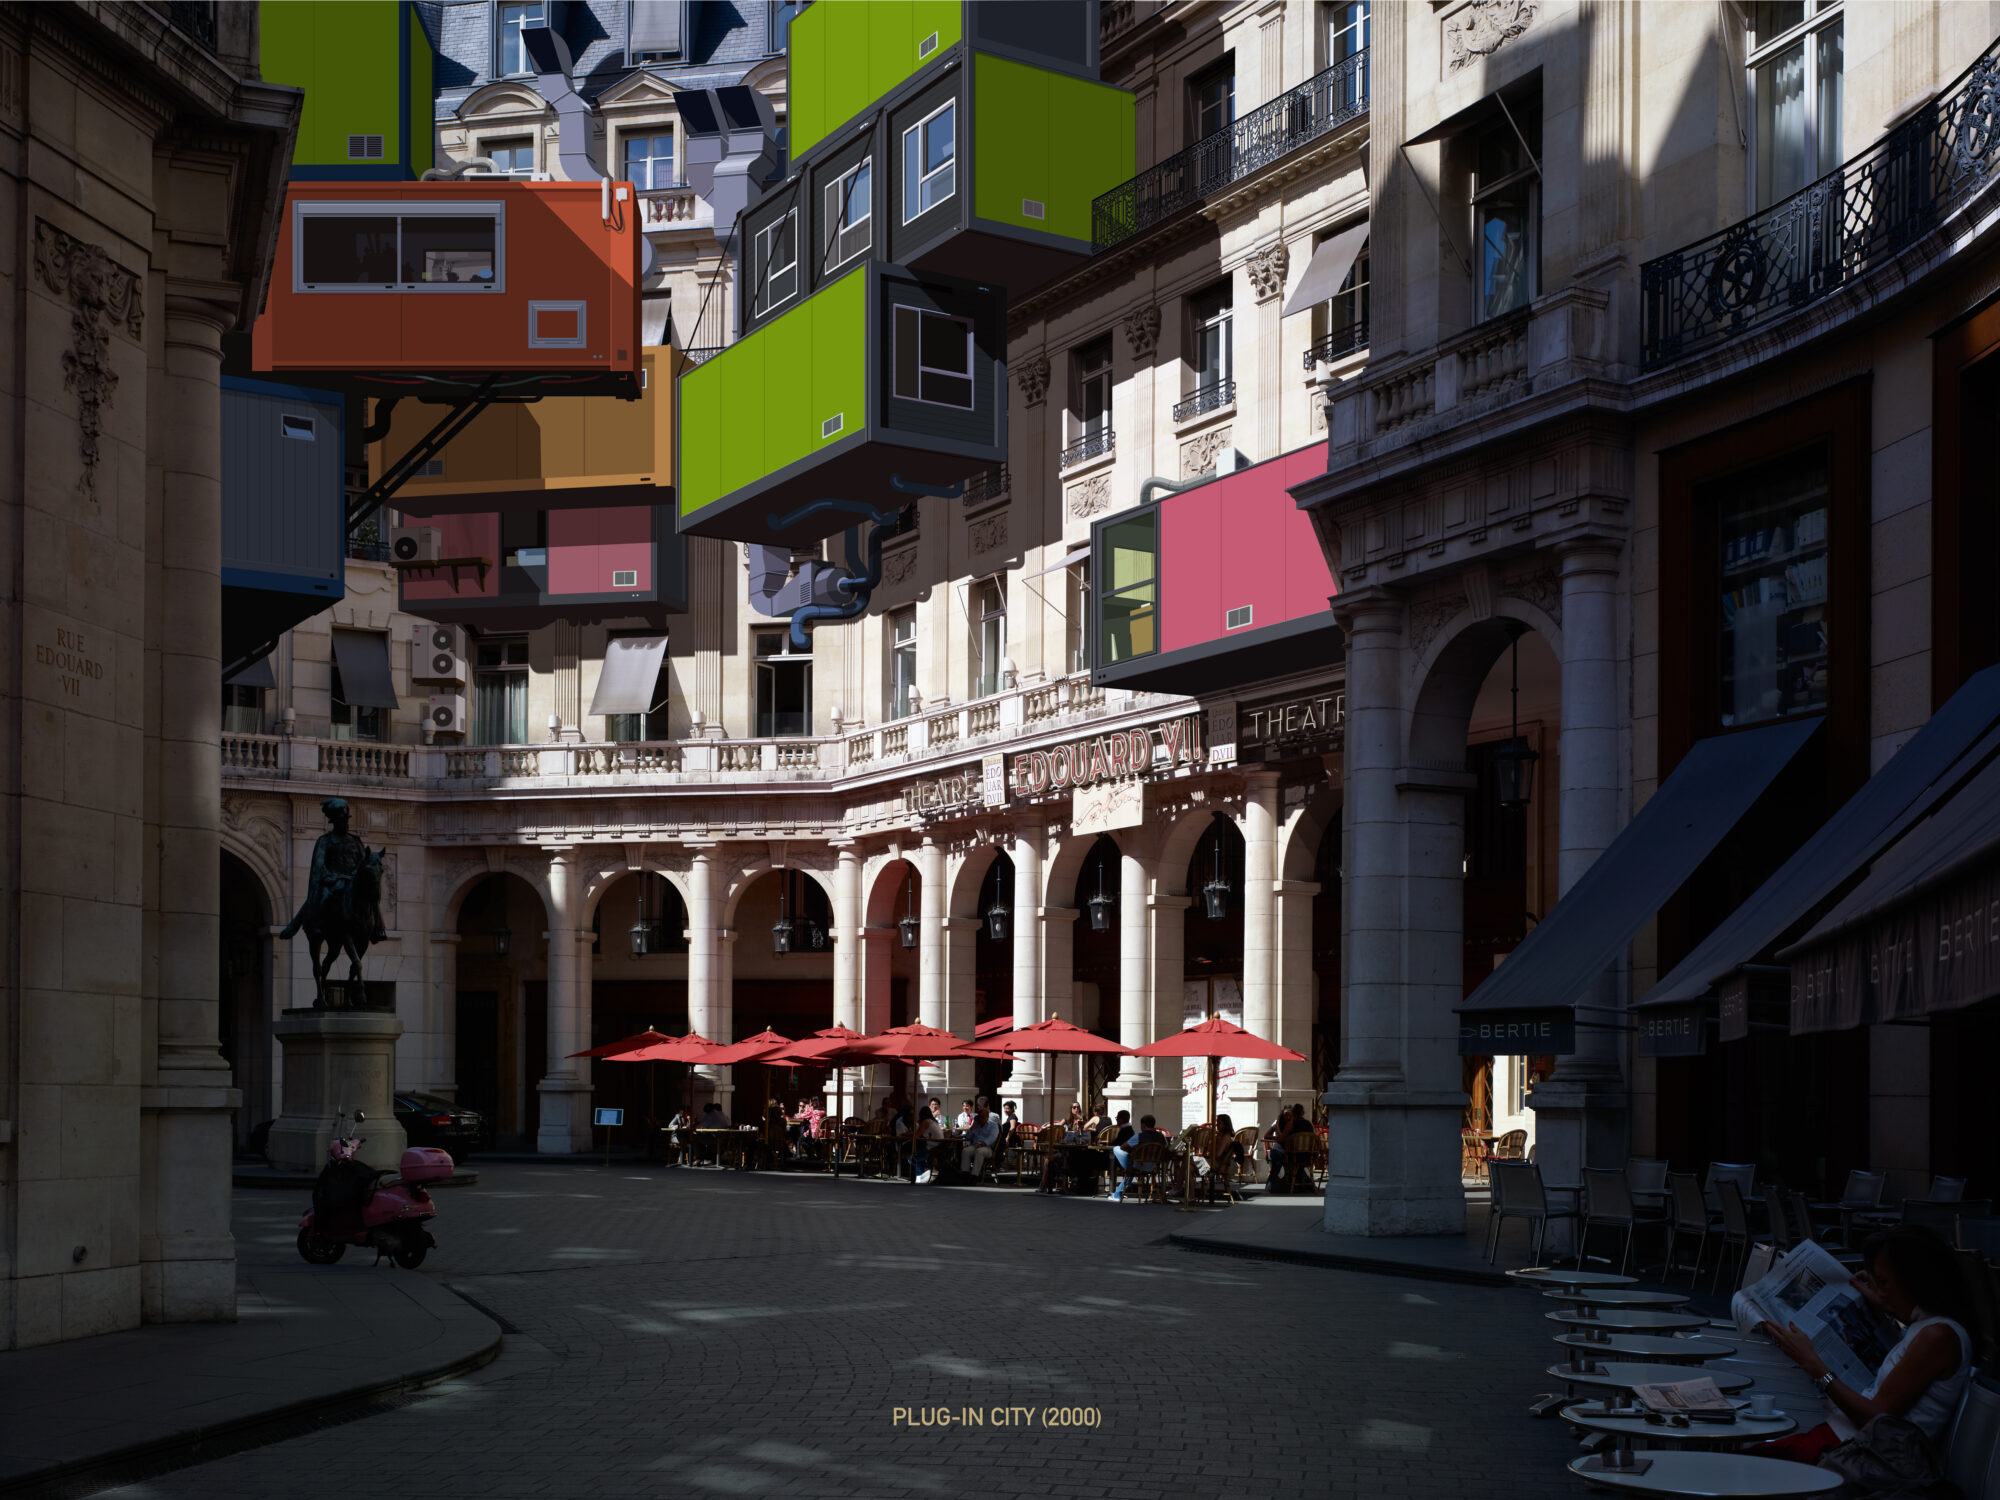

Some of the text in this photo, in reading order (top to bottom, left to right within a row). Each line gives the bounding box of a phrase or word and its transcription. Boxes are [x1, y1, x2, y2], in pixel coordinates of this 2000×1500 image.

[57, 628, 85, 653] RUE
[36, 644, 103, 680] EDOUARD
[62, 674, 80, 697] VII
[1015, 714, 1200, 797] EDOUARD VII
[1212, 746, 1233, 762] D.VII
[985, 766, 1002, 780] EDO
[900, 770, 975, 812] THEATRE
[1938, 899, 2000, 961] BERTIE
[1479, 1021, 1552, 1039] BERTIE
[1648, 1017, 1690, 1037] BERTIE
